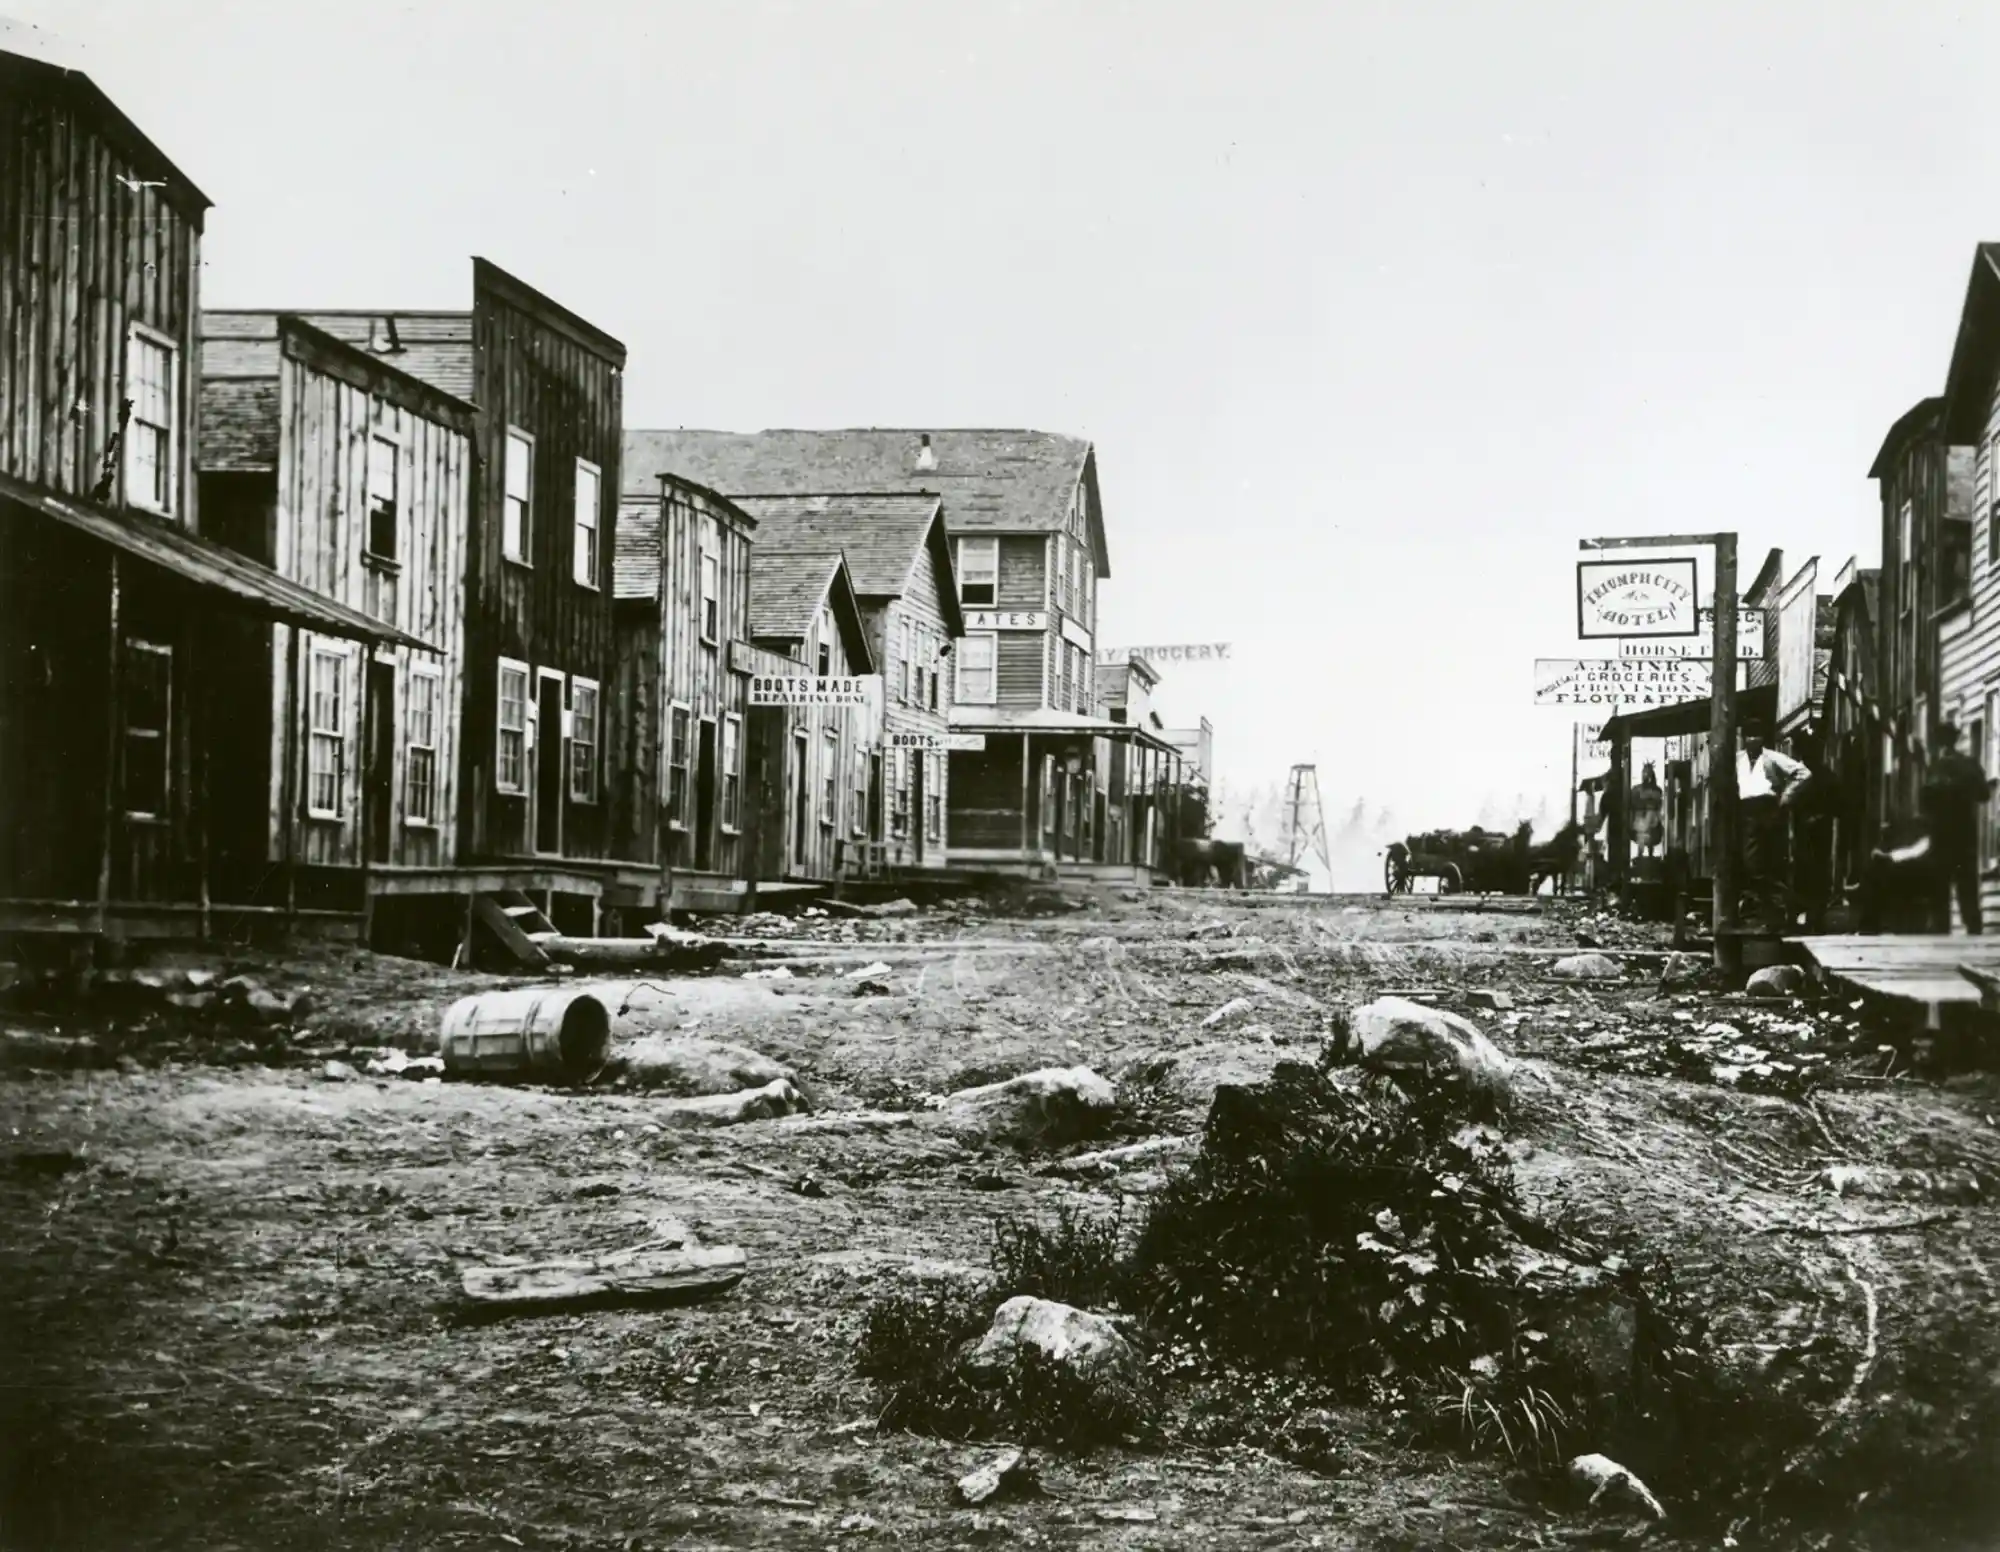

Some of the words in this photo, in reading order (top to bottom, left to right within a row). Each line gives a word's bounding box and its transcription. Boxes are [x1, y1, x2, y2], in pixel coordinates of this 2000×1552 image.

[1584, 572, 1651, 604] TRIUMPH
[1654, 574, 1692, 601] CITY
[1602, 607, 1669, 626] HOTEL
[1625, 645, 1692, 656] HORSE
[753, 678, 809, 693] BOOTS
[816, 680, 863, 693] MADE
[1555, 693, 1637, 703] FLOUR
